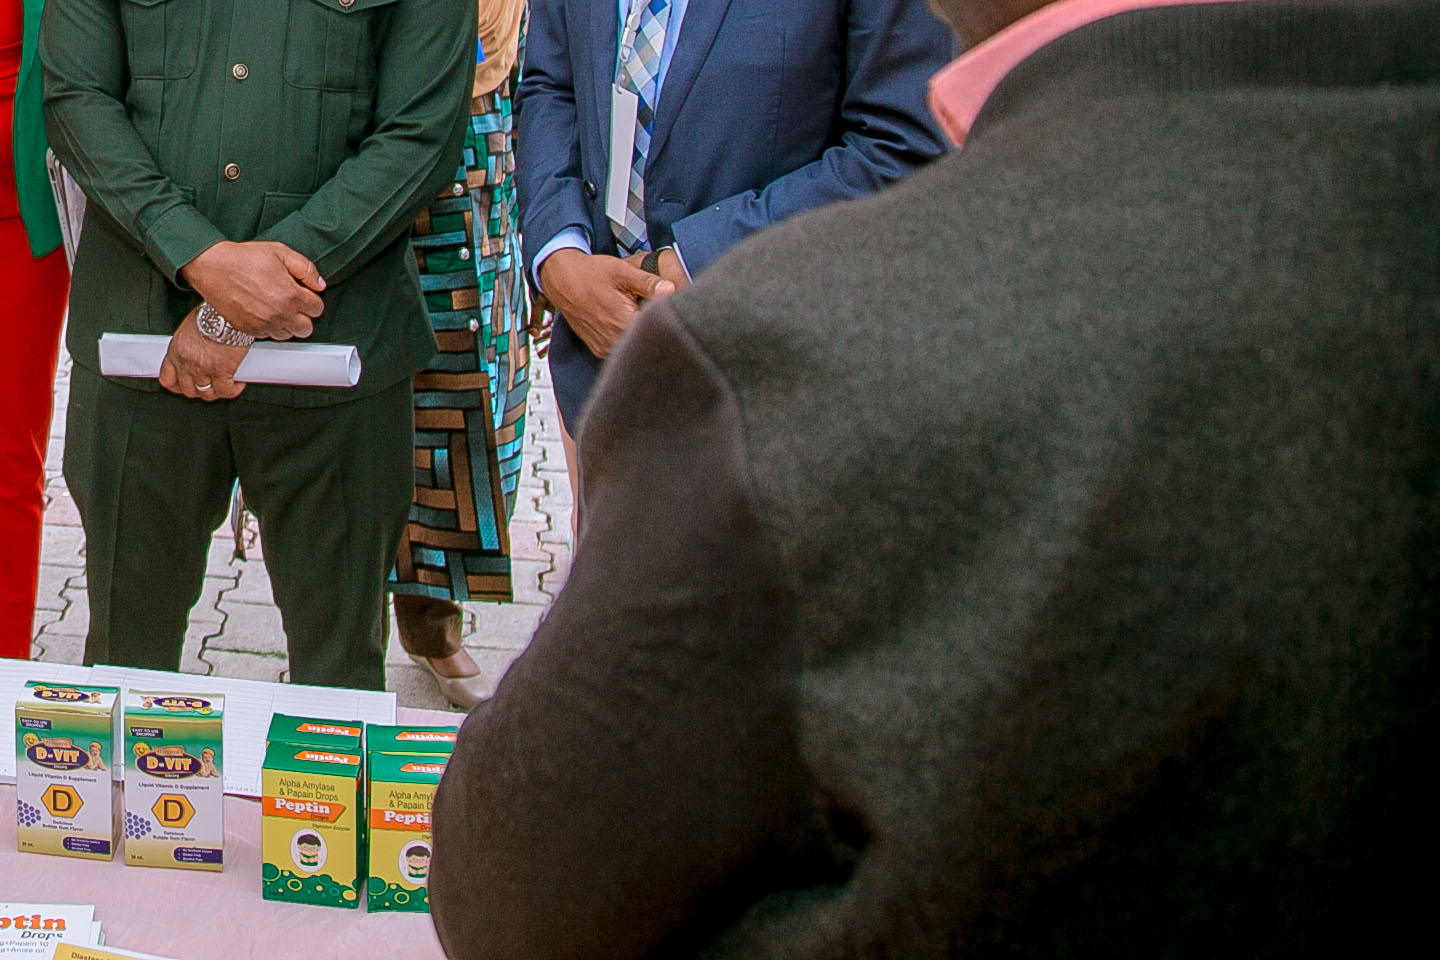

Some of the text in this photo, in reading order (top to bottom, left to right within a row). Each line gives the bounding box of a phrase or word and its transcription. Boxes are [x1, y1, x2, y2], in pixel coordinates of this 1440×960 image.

[42, 691, 81, 699] D-VIT
[308, 725, 349, 735] Peptin
[35, 747, 80, 763] D-VIT
[306, 753, 348, 763] Peptin
[146, 756, 192, 770] D-VIT
[279, 778, 335, 791] Alpha Amylase
[53, 790, 72, 812] D
[287, 788, 314, 799] Papain
[316, 791, 338, 802] Drops
[389, 790, 433, 801] Alpha Amyl
[164, 800, 183, 821] D
[275, 798, 330, 814] Peptin
[397, 801, 425, 810] Papain
[384, 811, 432, 825] Pepti
[21, 931, 63, 941] Drops
